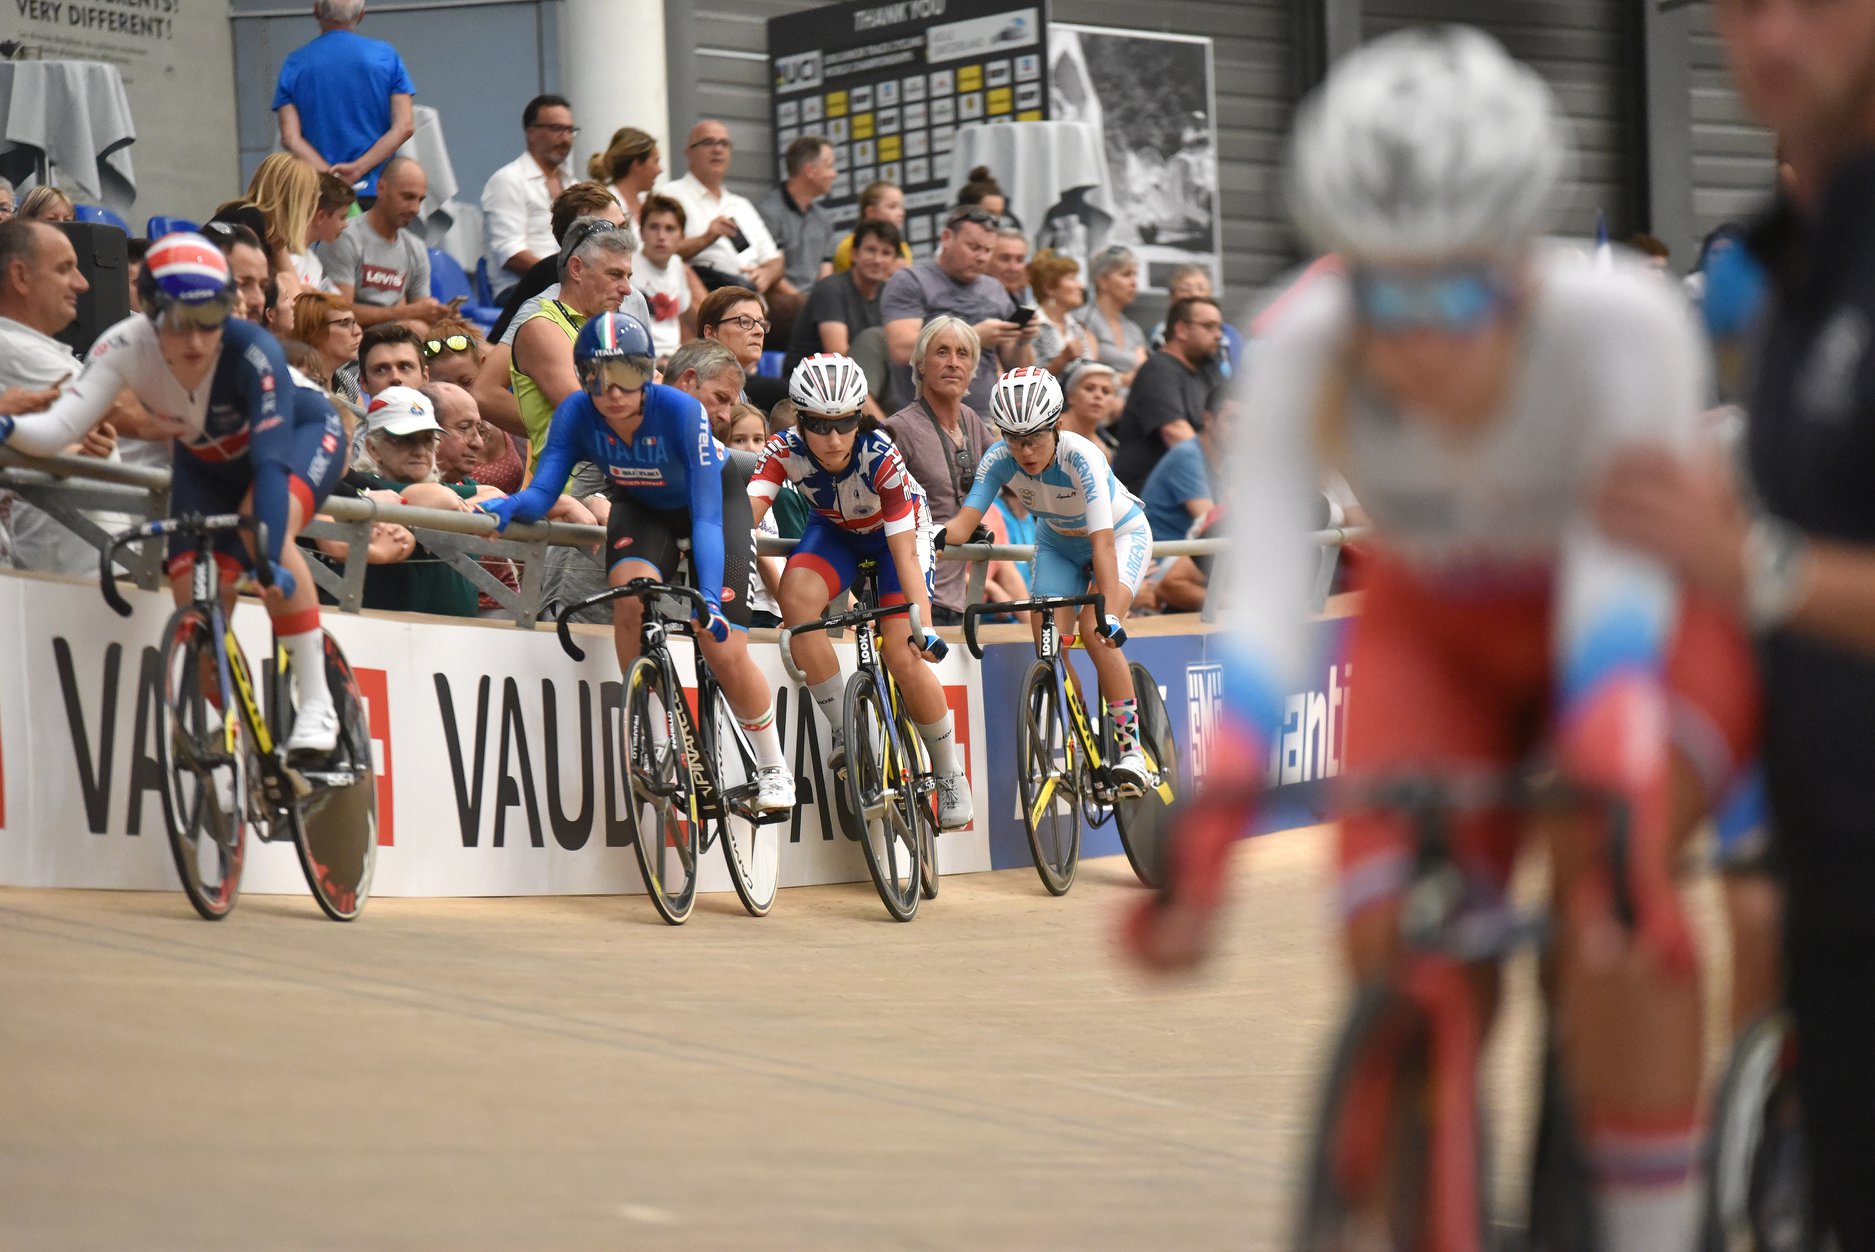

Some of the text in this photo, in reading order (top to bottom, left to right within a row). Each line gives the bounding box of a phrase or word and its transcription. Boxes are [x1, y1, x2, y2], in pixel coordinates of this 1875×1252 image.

[594, 430, 669, 464] ITALIA
[859, 633, 871, 663] LOOK
[1042, 628, 1051, 656] LOOK
